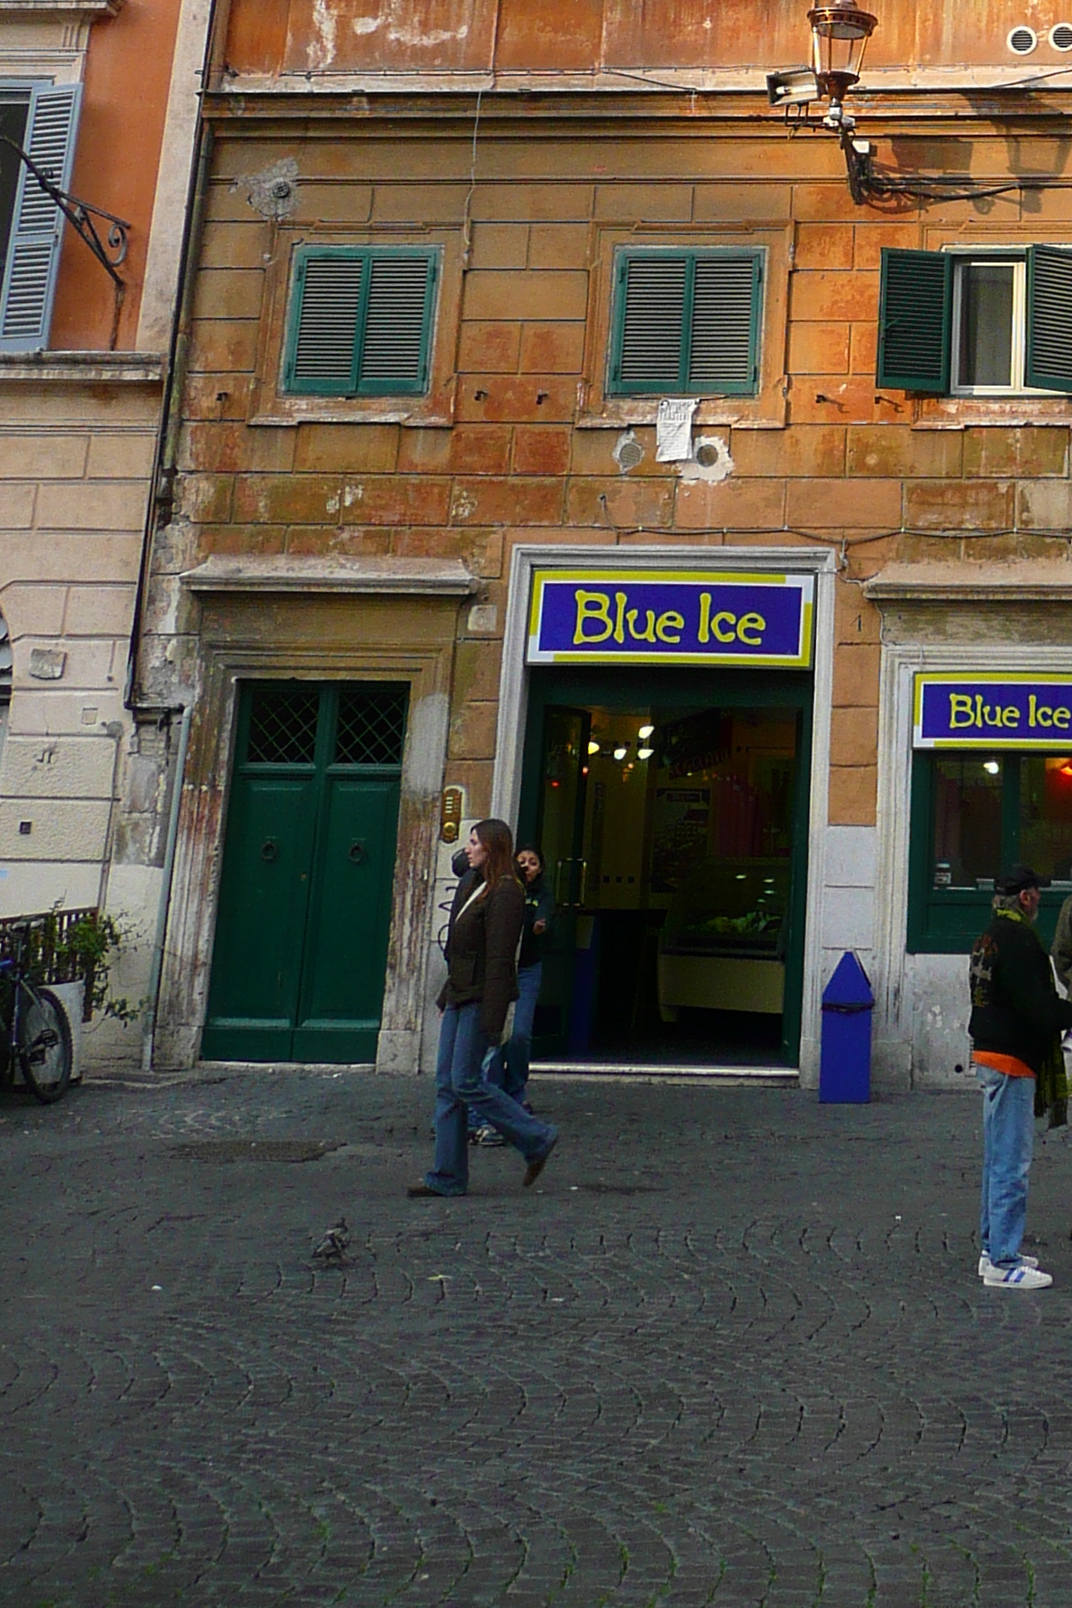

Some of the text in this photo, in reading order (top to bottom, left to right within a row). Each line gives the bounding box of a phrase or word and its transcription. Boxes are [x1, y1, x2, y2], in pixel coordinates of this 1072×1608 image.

[573, 589, 766, 645] Blue Ice
[949, 693, 1071, 728] Blue Ice
